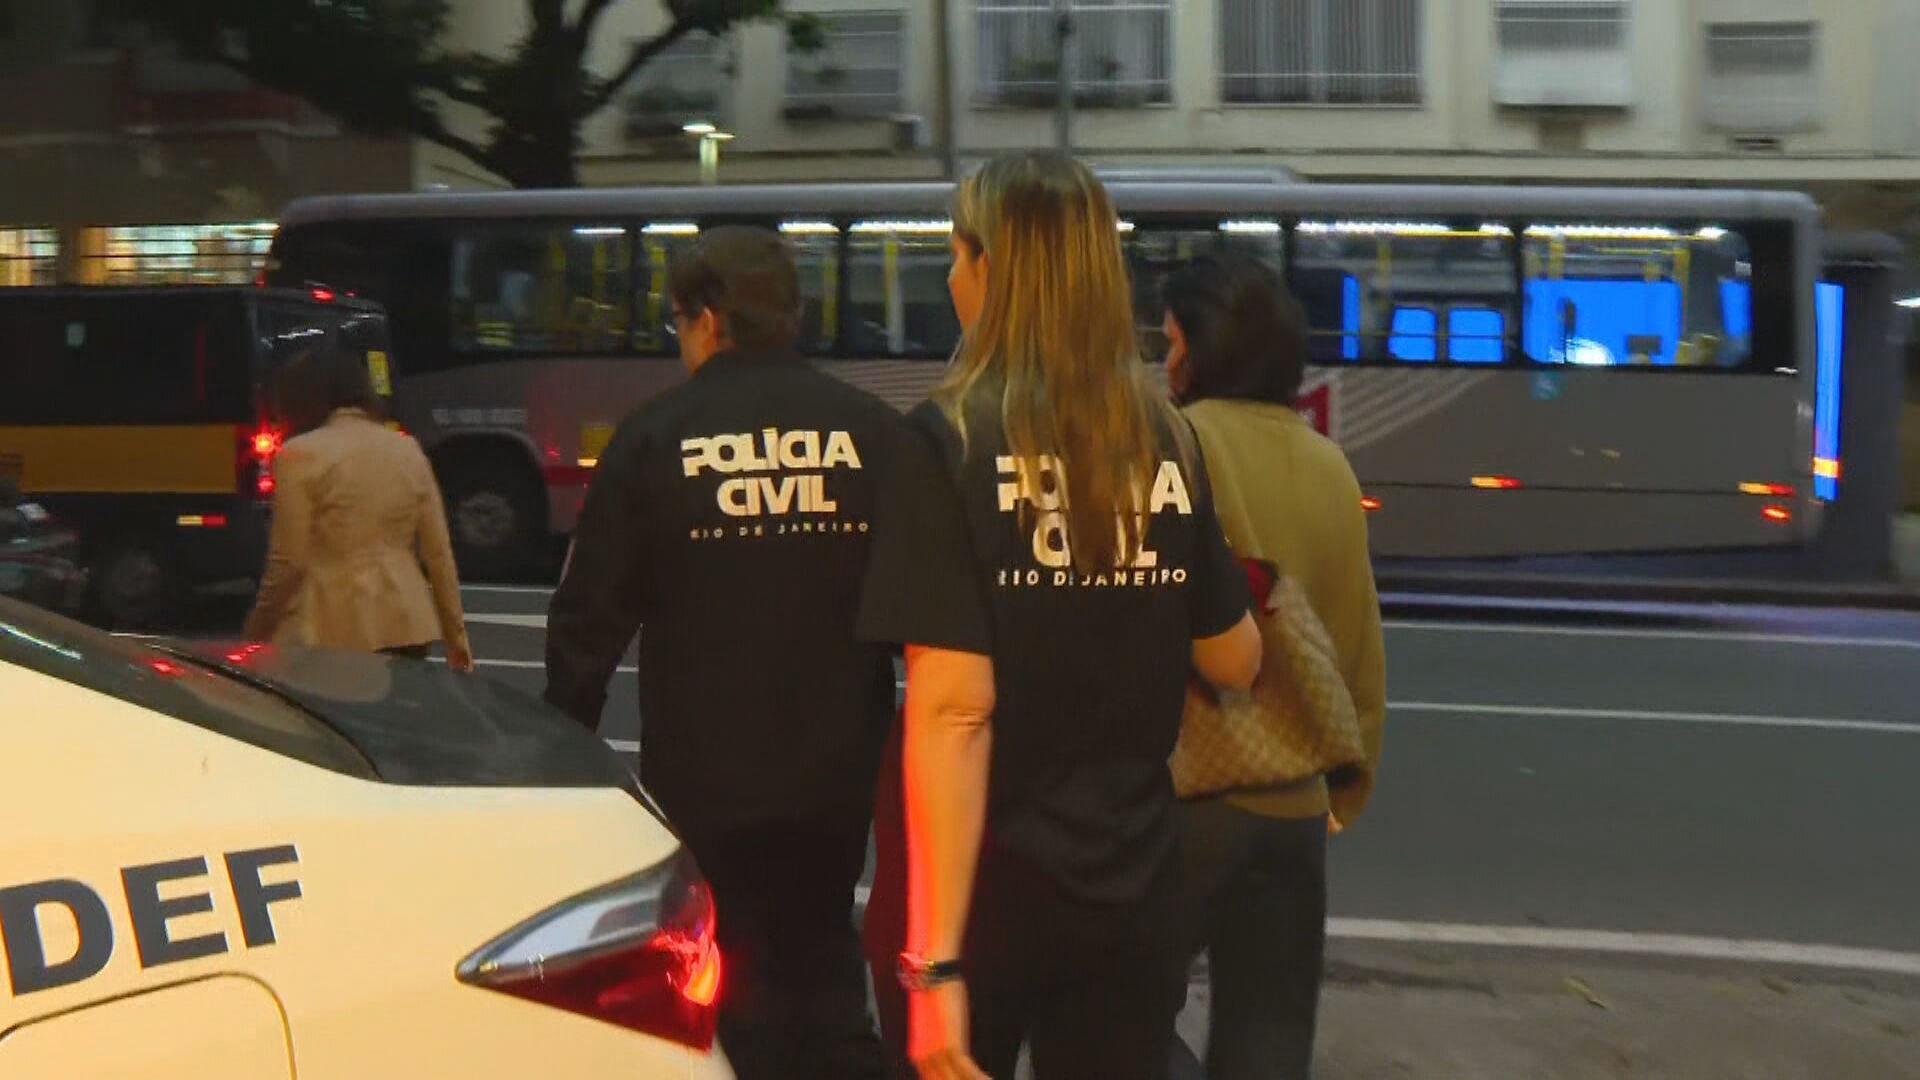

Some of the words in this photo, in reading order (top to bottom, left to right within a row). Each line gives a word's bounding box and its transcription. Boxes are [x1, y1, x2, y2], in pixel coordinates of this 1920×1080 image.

[717, 475, 837, 516] CIVIL
[690, 528, 723, 538] RIO
[738, 526, 763, 536] DE
[777, 522, 869, 534] JANEIRO
